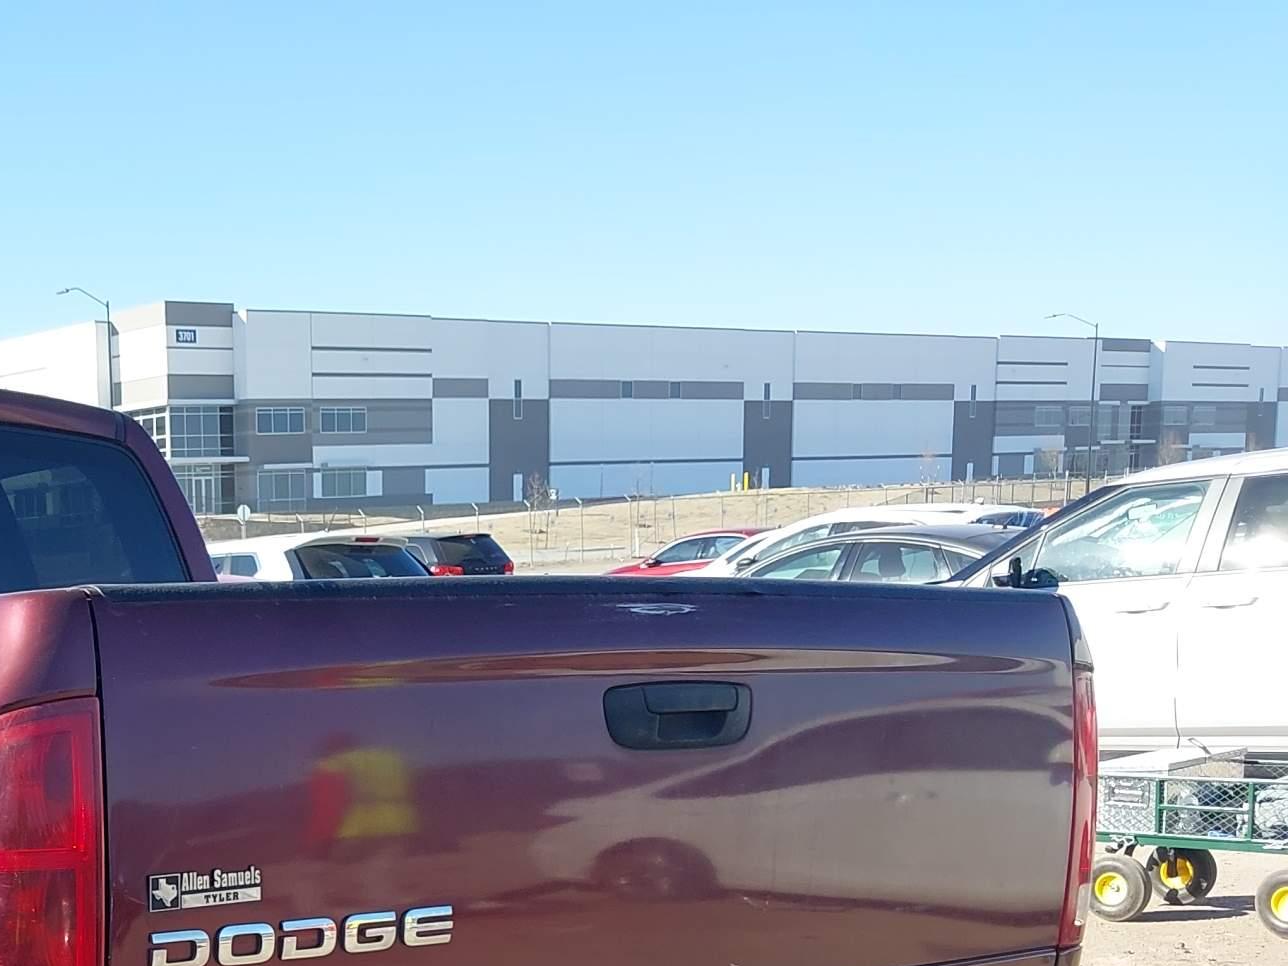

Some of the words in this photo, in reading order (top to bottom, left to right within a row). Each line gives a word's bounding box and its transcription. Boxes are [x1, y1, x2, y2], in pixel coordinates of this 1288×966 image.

[182, 872, 210, 892] Allen
[213, 866, 261, 888] Samuels
[204, 892, 239, 904] TYLER
